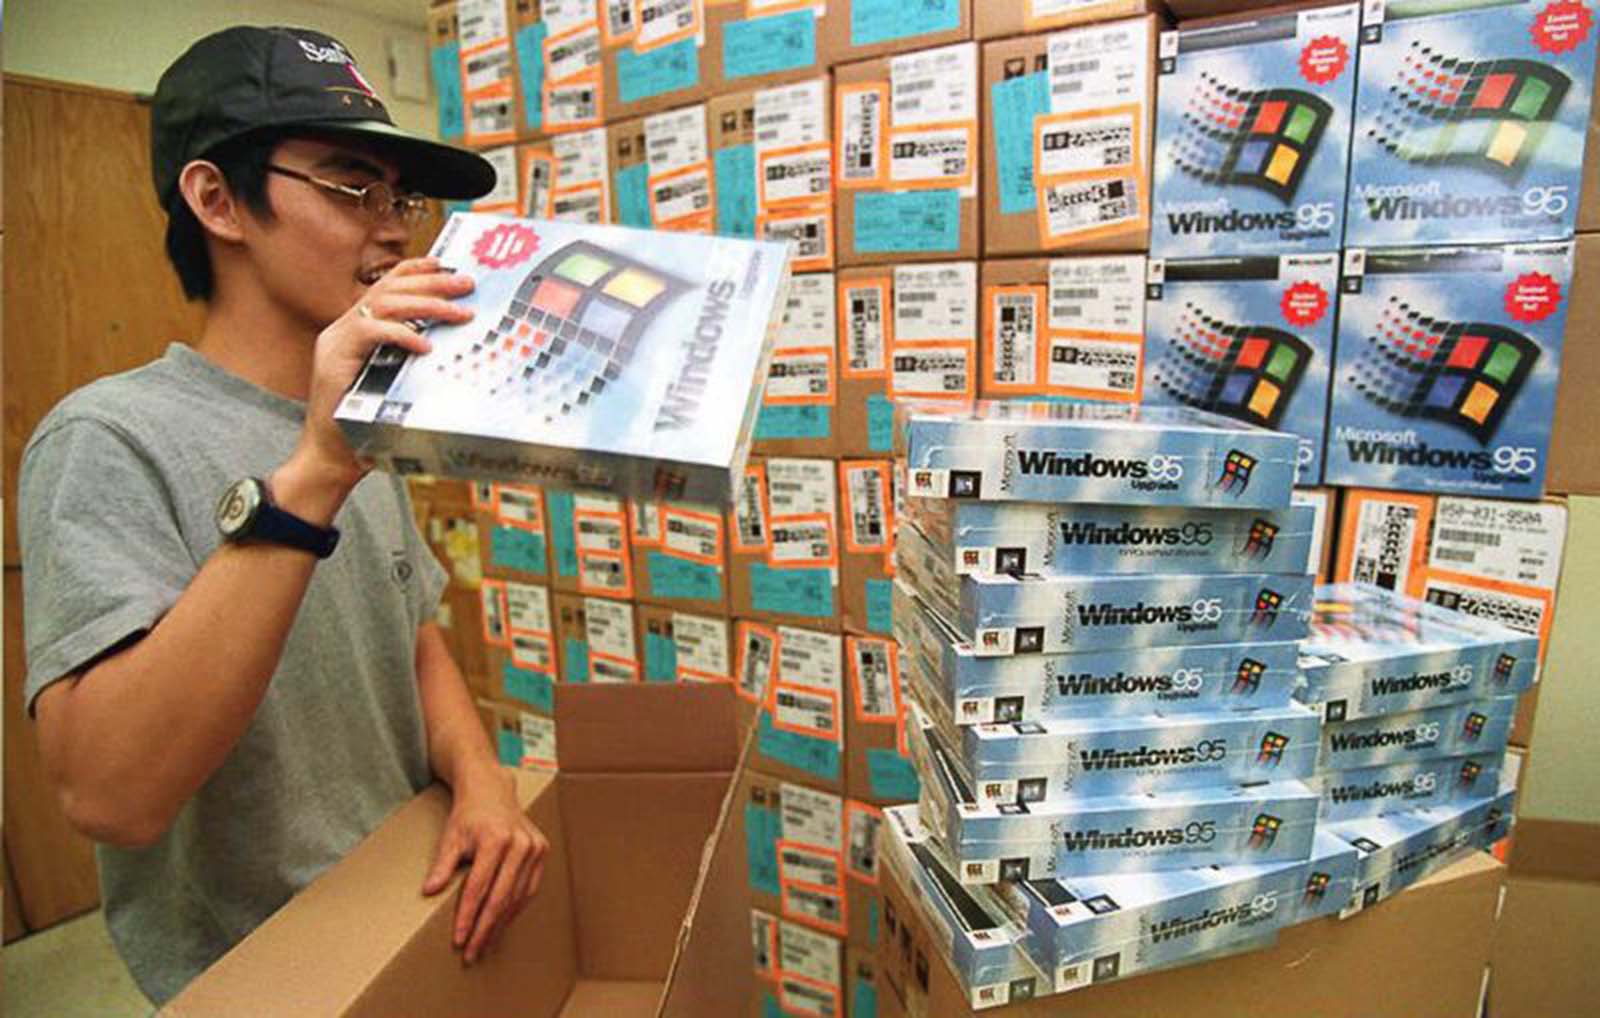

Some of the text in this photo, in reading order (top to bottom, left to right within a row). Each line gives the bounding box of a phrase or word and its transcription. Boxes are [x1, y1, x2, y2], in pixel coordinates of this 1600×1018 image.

[1354, 180, 1441, 198] Microsoft
[1366, 185, 1569, 222] Windows 95
[1167, 202, 1335, 236] Windows 95
[653, 279, 736, 434] Windows
[1334, 425, 1418, 445] Microsoft
[1017, 450, 1149, 479] Windows
[1149, 455, 1183, 482] 95
[1347, 440, 1536, 475] Windows 95
[1130, 480, 1180, 491] Upgrade
[1061, 522, 1181, 545] Windows
[1181, 522, 1213, 546] 95
[1077, 598, 1223, 626] Windows 95
[1057, 668, 1203, 696] Windows 95
[1371, 664, 1473, 697] Windows 95
[1331, 721, 1440, 752] Windows 95
[1080, 746, 1194, 771] Windows
[1194, 738, 1227, 762] 95
[1331, 771, 1437, 805] Windows 95
[1064, 827, 1184, 852] Windows
[1184, 820, 1217, 844] 95
[1151, 902, 1251, 944] Windows
[1249, 890, 1279, 917] 95
